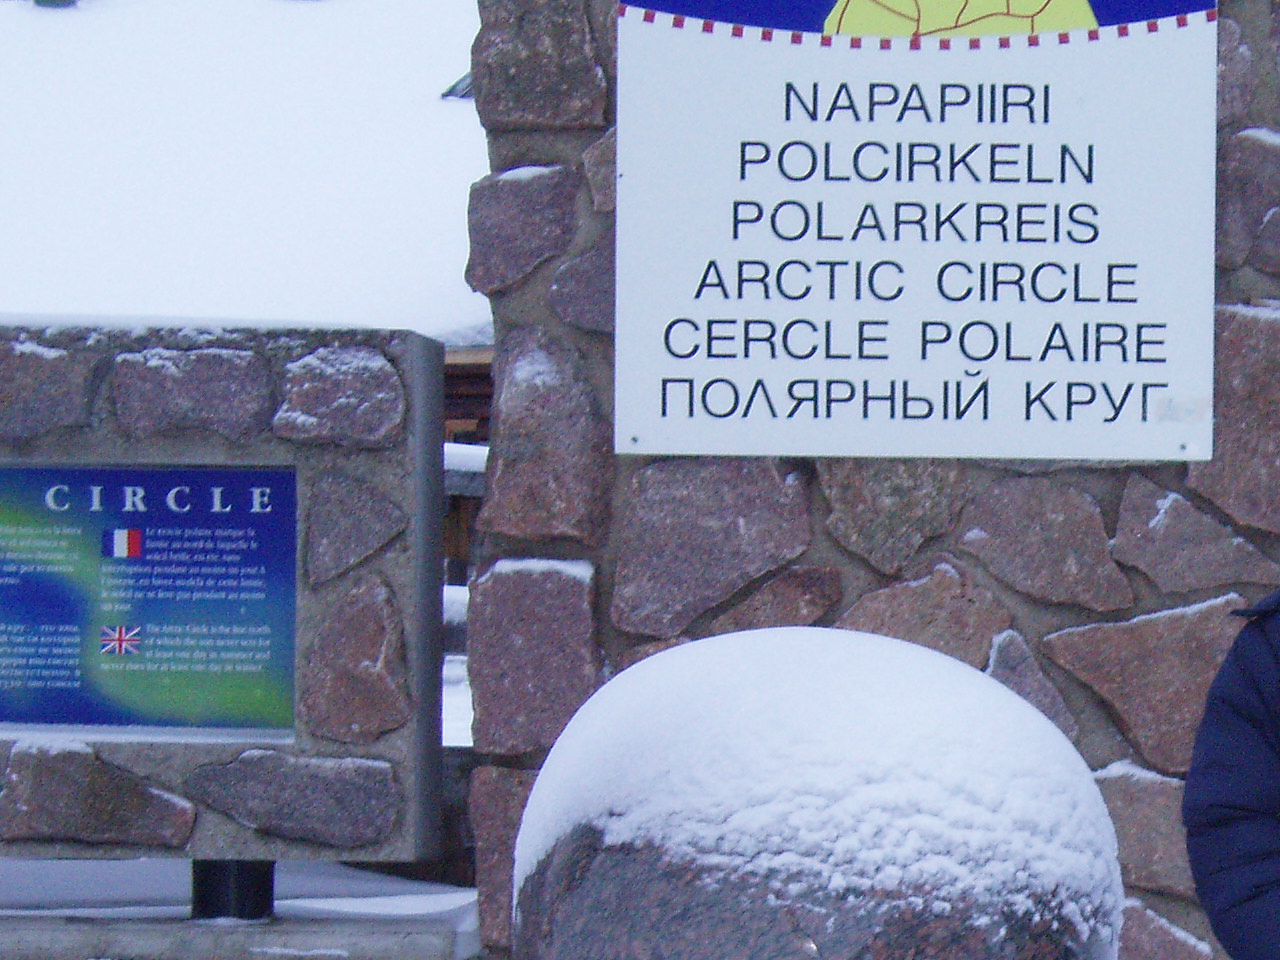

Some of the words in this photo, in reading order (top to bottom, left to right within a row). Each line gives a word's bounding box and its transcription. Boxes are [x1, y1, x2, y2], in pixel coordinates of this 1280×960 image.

[784, 82, 1051, 124] NAPAPIIRI
[738, 141, 1095, 184] POLCIRKELN
[731, 200, 1100, 244] POLARKREIS
[694, 260, 905, 301] ARCTIC
[936, 262, 1139, 304] CIRCLE
[662, 319, 890, 360] CERCLE
[920, 321, 1168, 364] POLAIRE
[660, 368, 990, 421] ПОЛЯРНЫЙ
[1024, 381, 1169, 424] КРУГ
[44, 484, 273, 514] CIRCLE
